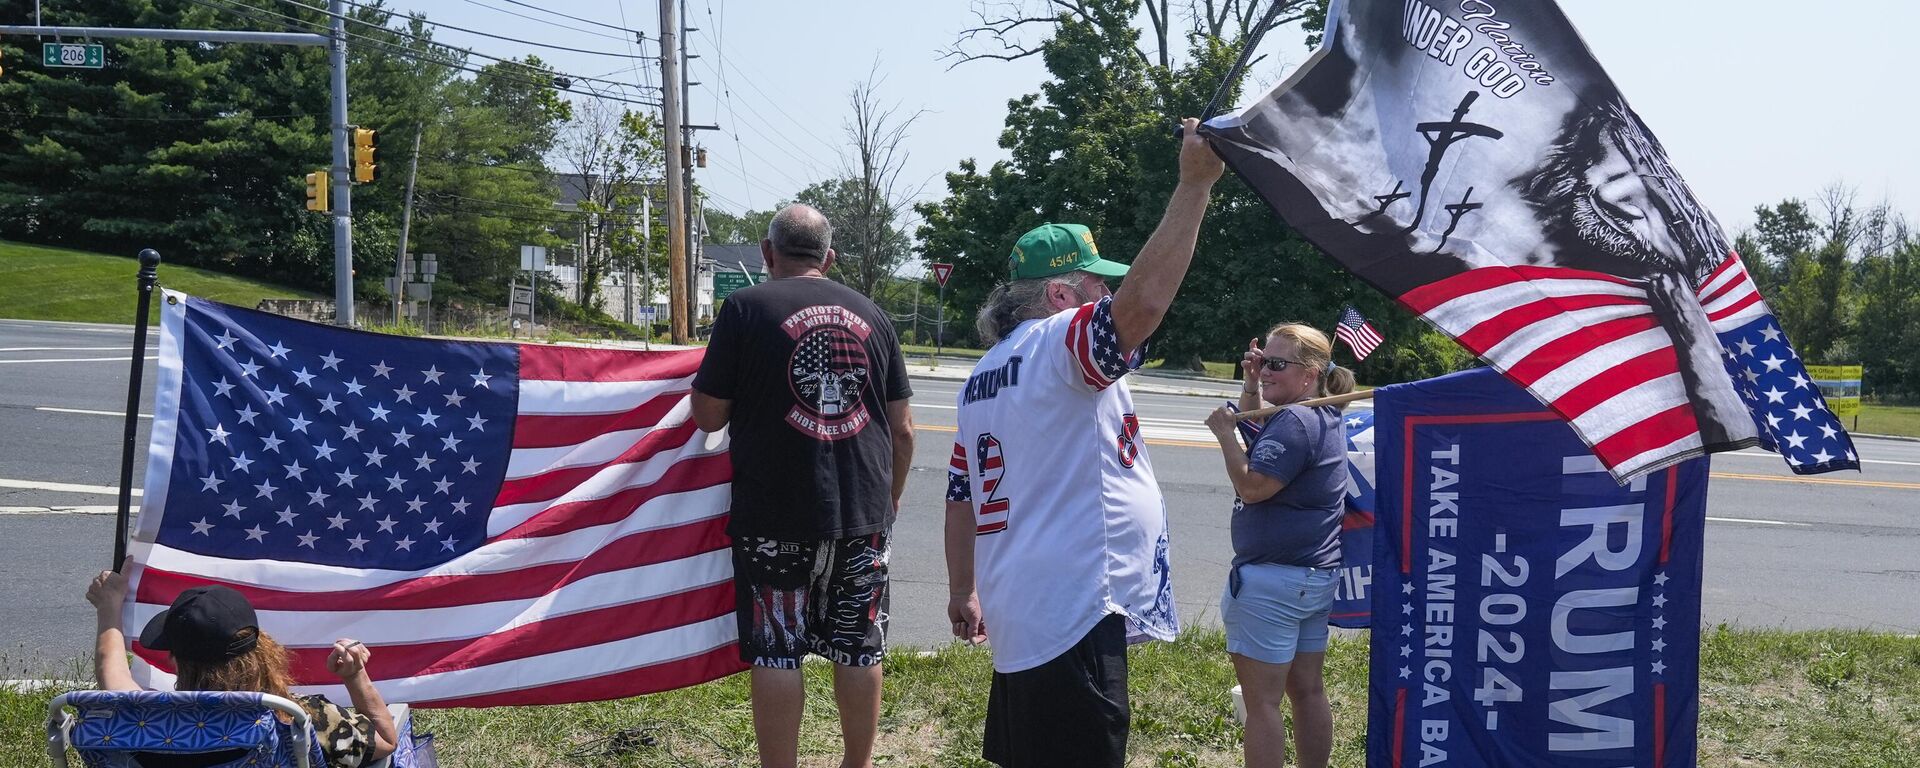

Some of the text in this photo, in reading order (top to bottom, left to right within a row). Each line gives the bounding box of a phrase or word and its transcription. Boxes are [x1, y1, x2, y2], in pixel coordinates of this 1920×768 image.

[63, 49, 84, 61] 206
[92, 48, 97, 56] S
[1402, 0, 1526, 99] UNDER GOD
[1459, 0, 1554, 86] Nation
[1049, 252, 1078, 268] 45/47
[785, 305, 869, 331] PATRIOTS RIDE
[803, 314, 854, 329] WITH DJT
[790, 408, 869, 436] RIDE FREE OR DIE
[976, 432, 1010, 536] 2
[1429, 444, 1460, 538] TAKE
[1422, 547, 1457, 708] AMERICA
[1548, 455, 1648, 768] RUM
[808, 633, 851, 666] ROUD
